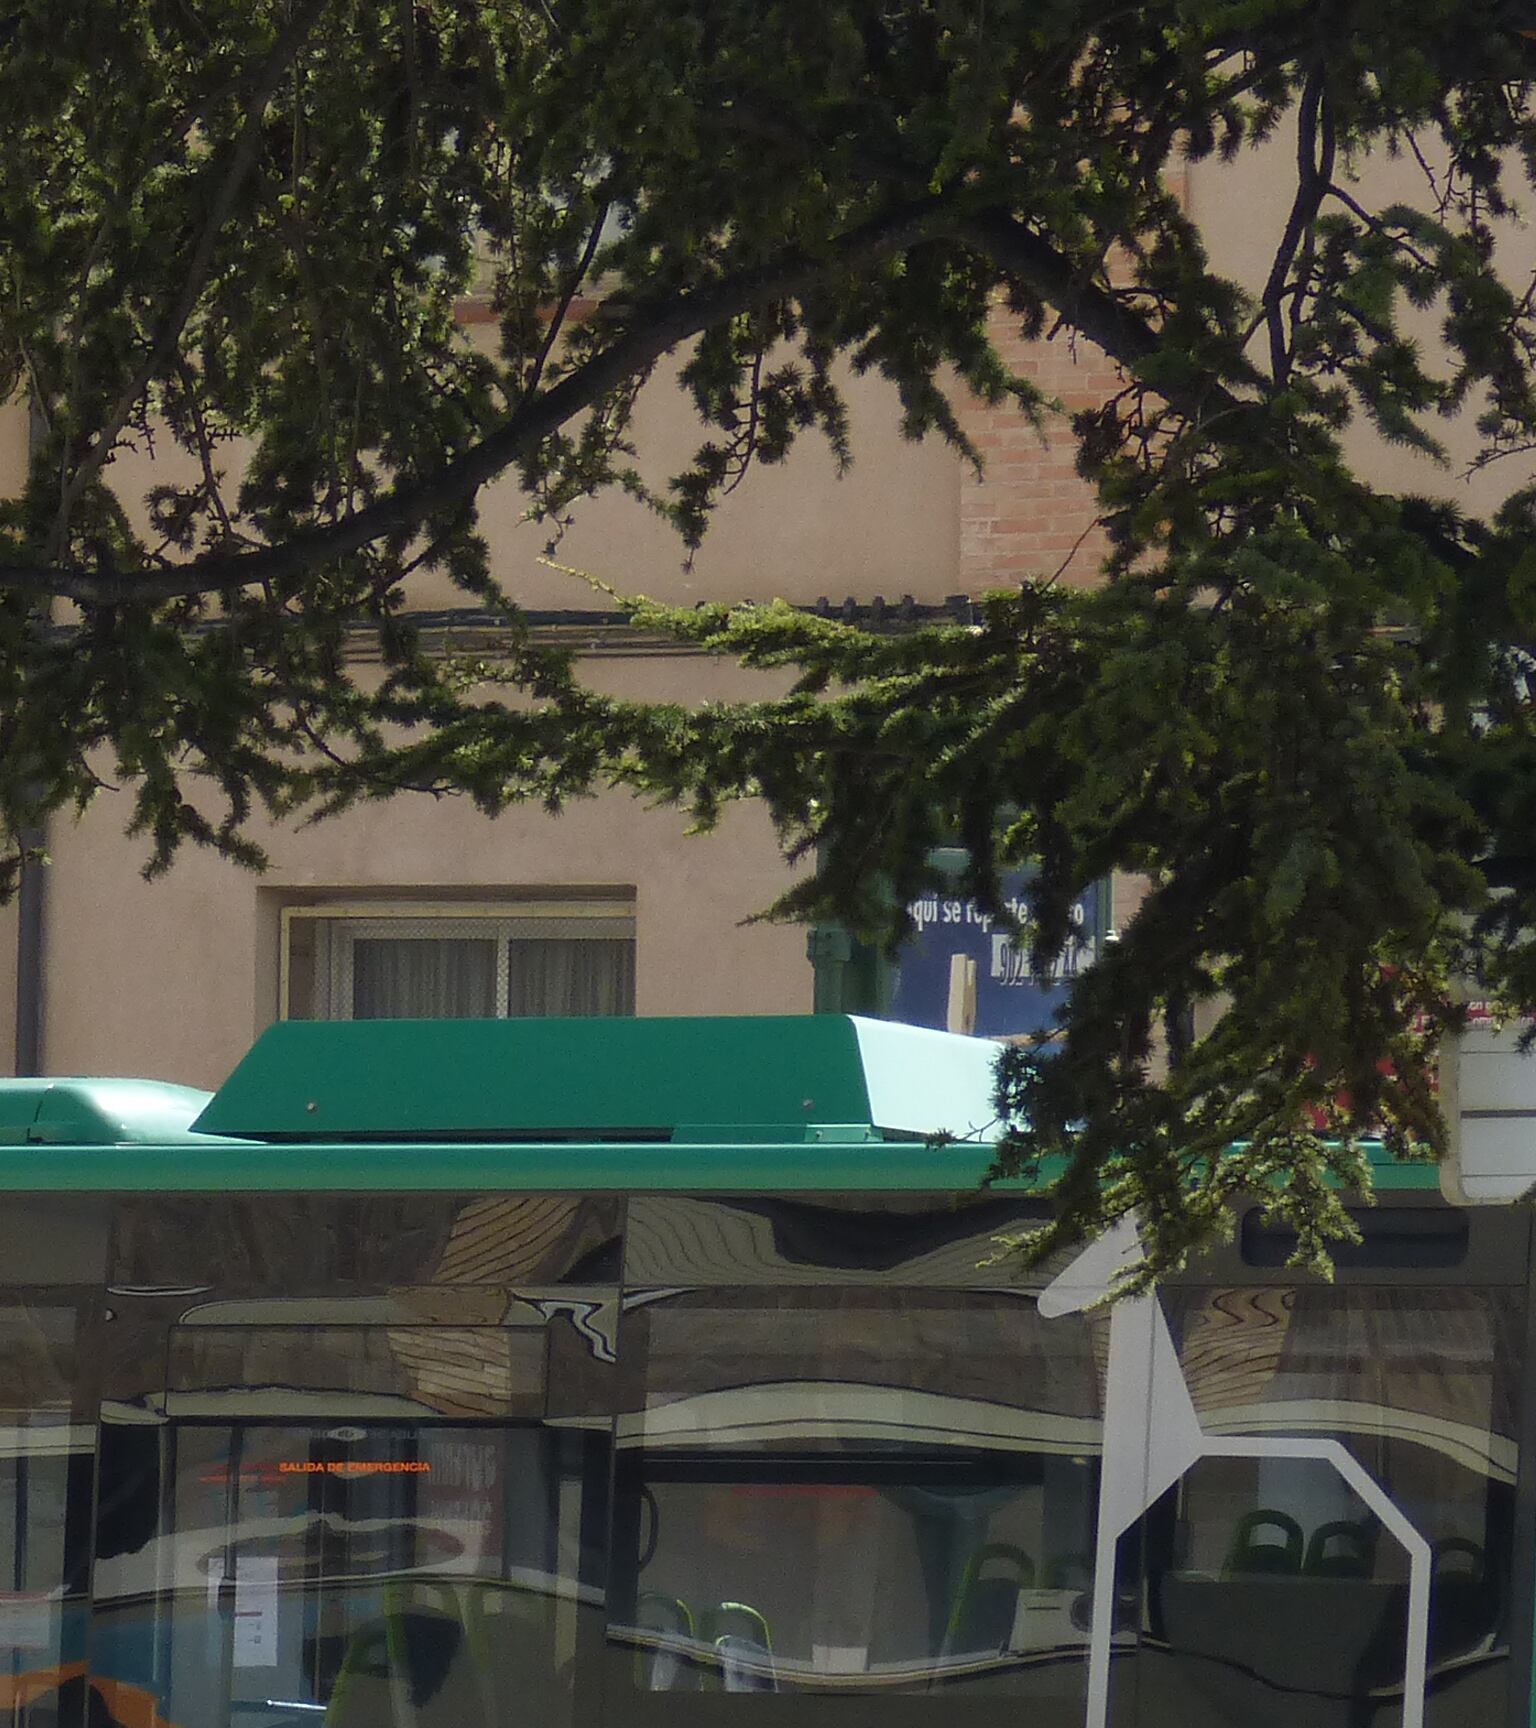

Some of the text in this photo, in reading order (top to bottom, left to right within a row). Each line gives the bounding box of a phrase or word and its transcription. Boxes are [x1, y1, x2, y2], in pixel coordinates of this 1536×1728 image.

[943, 900, 962, 923] se
[278, 1462, 431, 1473] SALIDA DE EMERGENCIA
